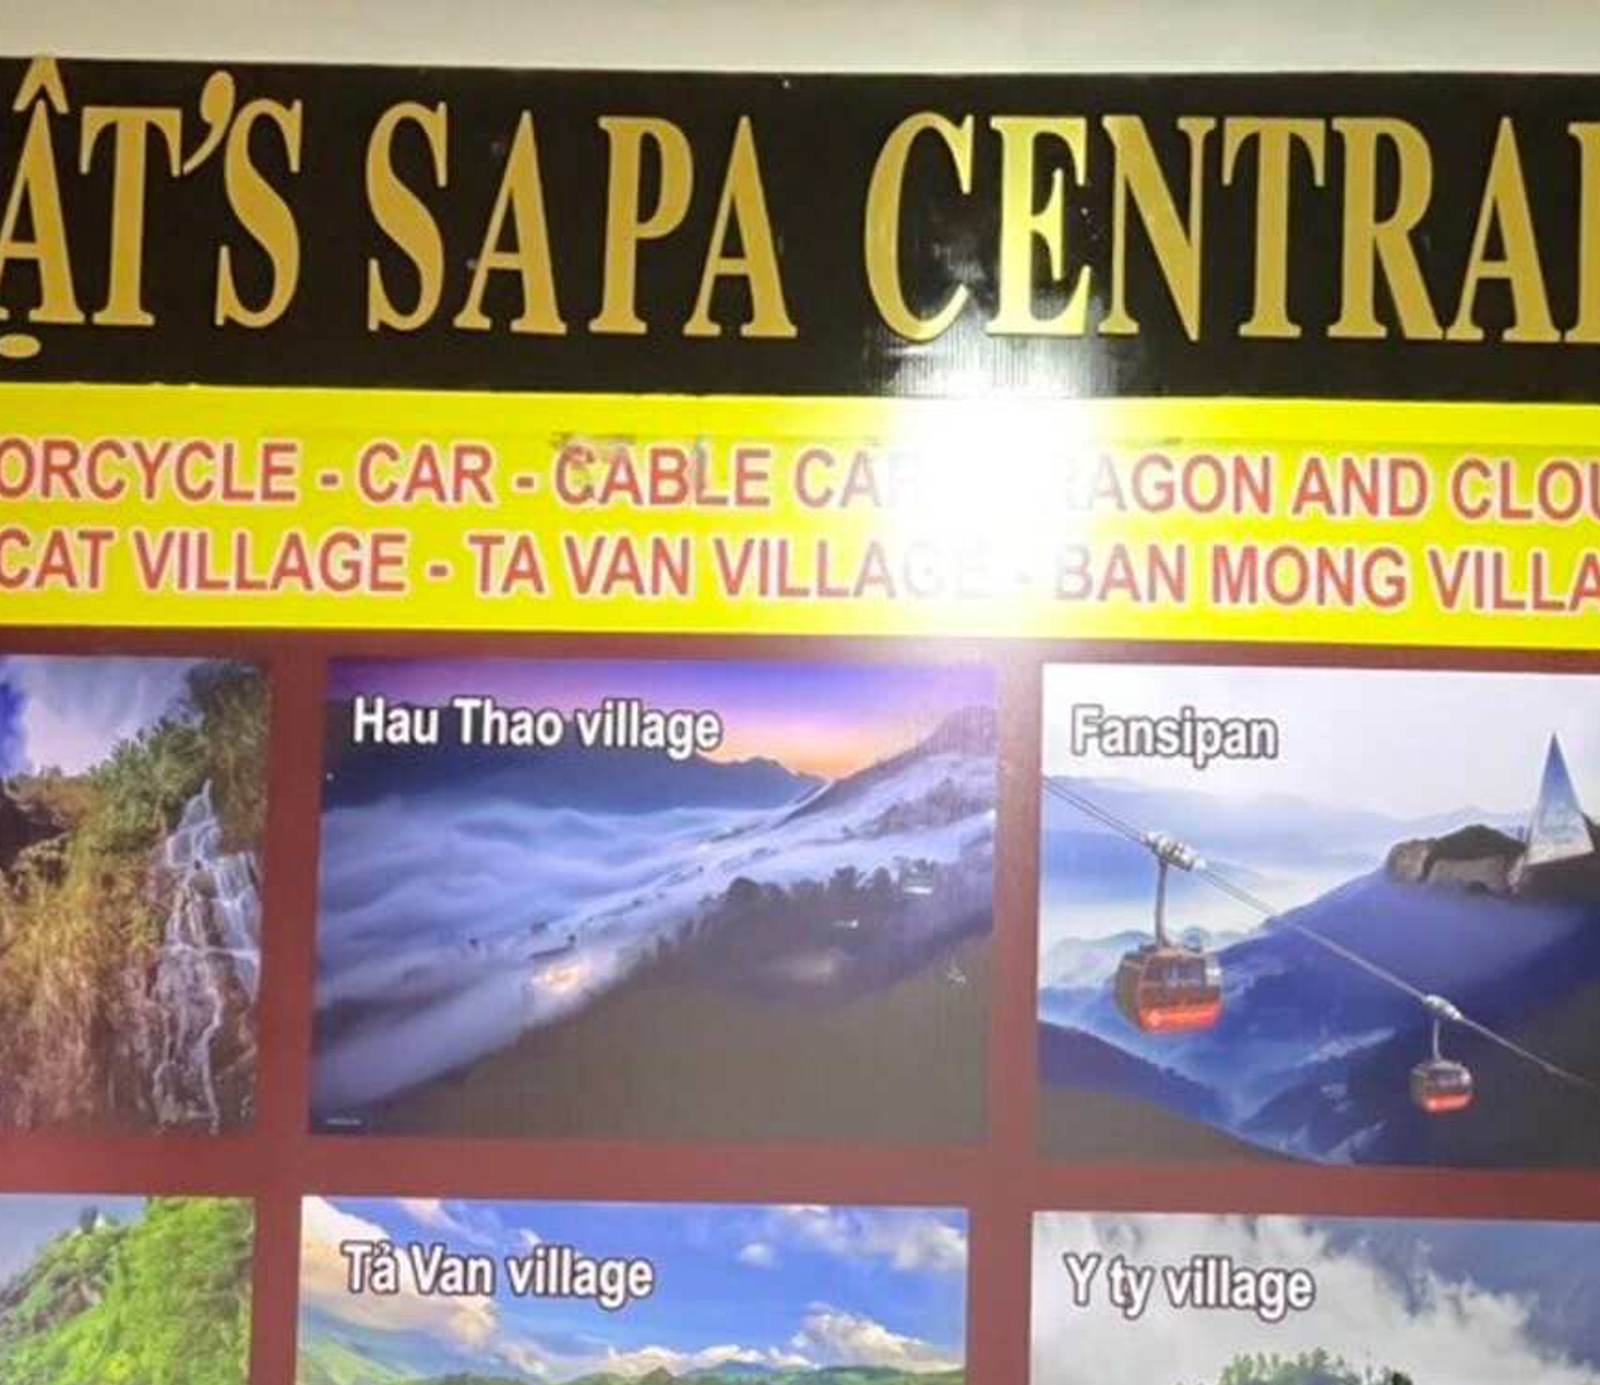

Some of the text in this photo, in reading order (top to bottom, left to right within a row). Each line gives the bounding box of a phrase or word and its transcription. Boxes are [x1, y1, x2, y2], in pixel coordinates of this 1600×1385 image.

[365, 100, 798, 339] SAPA
[0, 438, 297, 499] ORCYCLE
[358, 442, 494, 503] CAR
[555, 444, 771, 507] CABLE
[1292, 457, 1428, 517] AND
[1451, 459, 1600, 520] CLO
[133, 530, 407, 592] VILLAGE
[468, 534, 545, 593] TA
[563, 536, 691, 596] VAN
[1055, 542, 1187, 603] BAN
[1213, 545, 1406, 607] MONG
[1428, 550, 1600, 611] VILLA
[352, 696, 723, 761] Hau Thao village
[1071, 703, 1280, 770] Fansipan
[411, 1243, 495, 1297] Van
[506, 1246, 655, 1311] village
[1063, 1252, 1317, 1323] Y ty village
